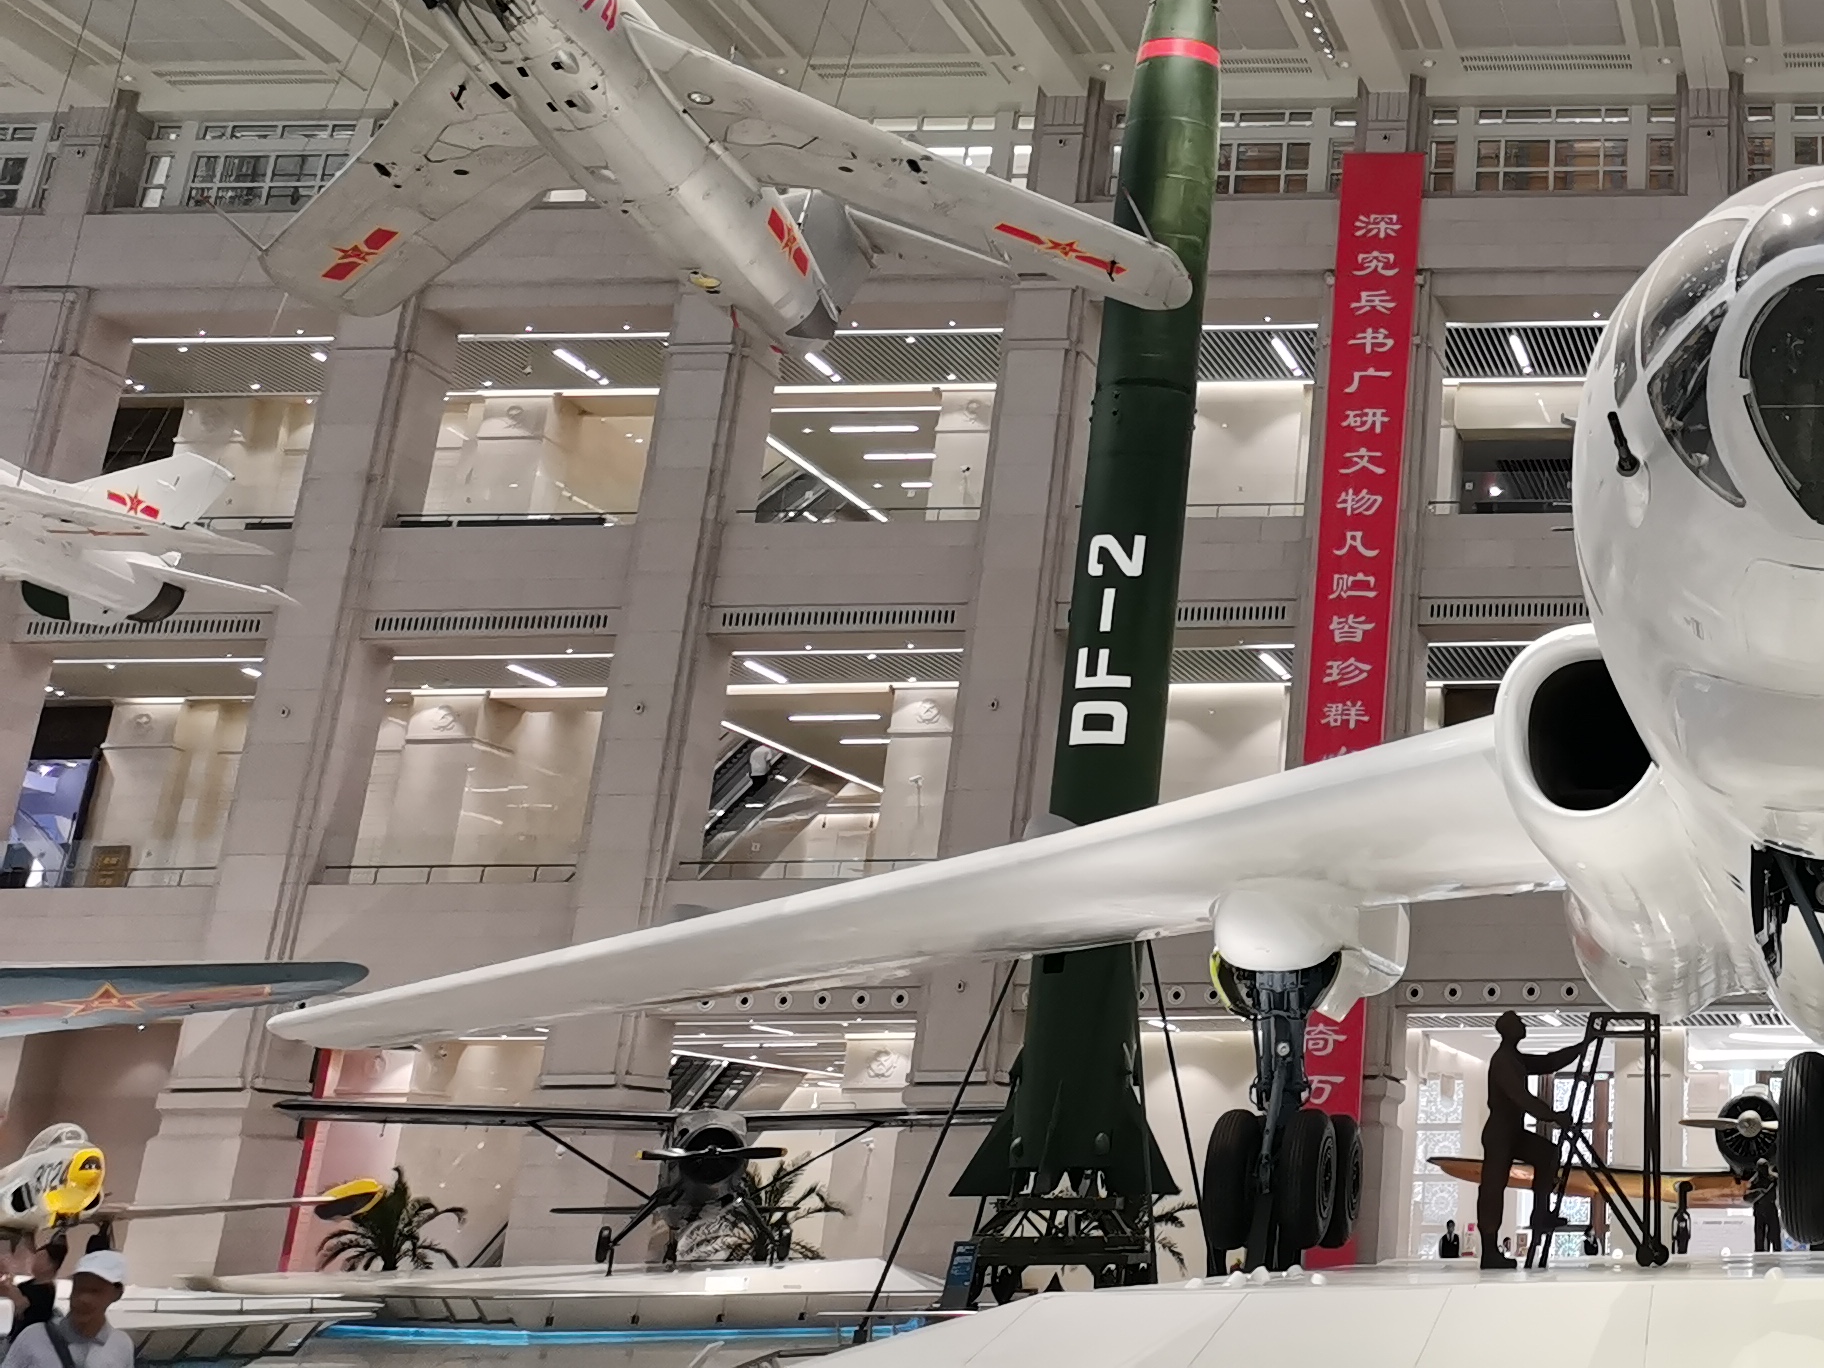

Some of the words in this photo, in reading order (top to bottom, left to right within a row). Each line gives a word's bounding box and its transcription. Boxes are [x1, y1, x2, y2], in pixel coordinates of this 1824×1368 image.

[1068, 533, 1147, 747] DF-2
[1319, 213, 1403, 760] 深究兵书广研文物凡贮皆珍群
